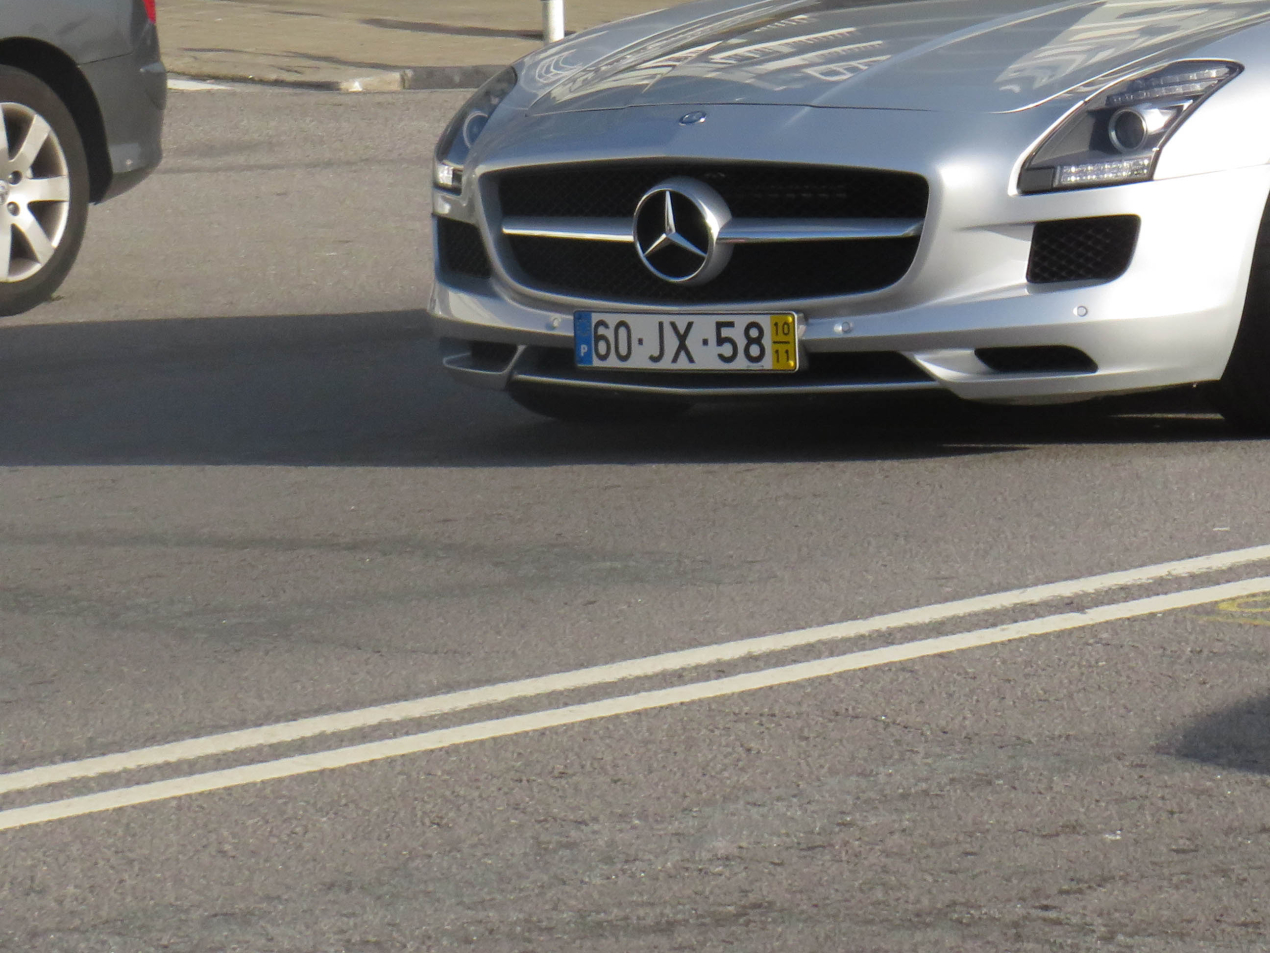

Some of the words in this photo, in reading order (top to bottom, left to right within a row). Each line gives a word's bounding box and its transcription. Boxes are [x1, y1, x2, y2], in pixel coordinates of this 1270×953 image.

[773, 321, 791, 337] 10
[580, 344, 588, 357] P
[774, 348, 791, 364] 11
